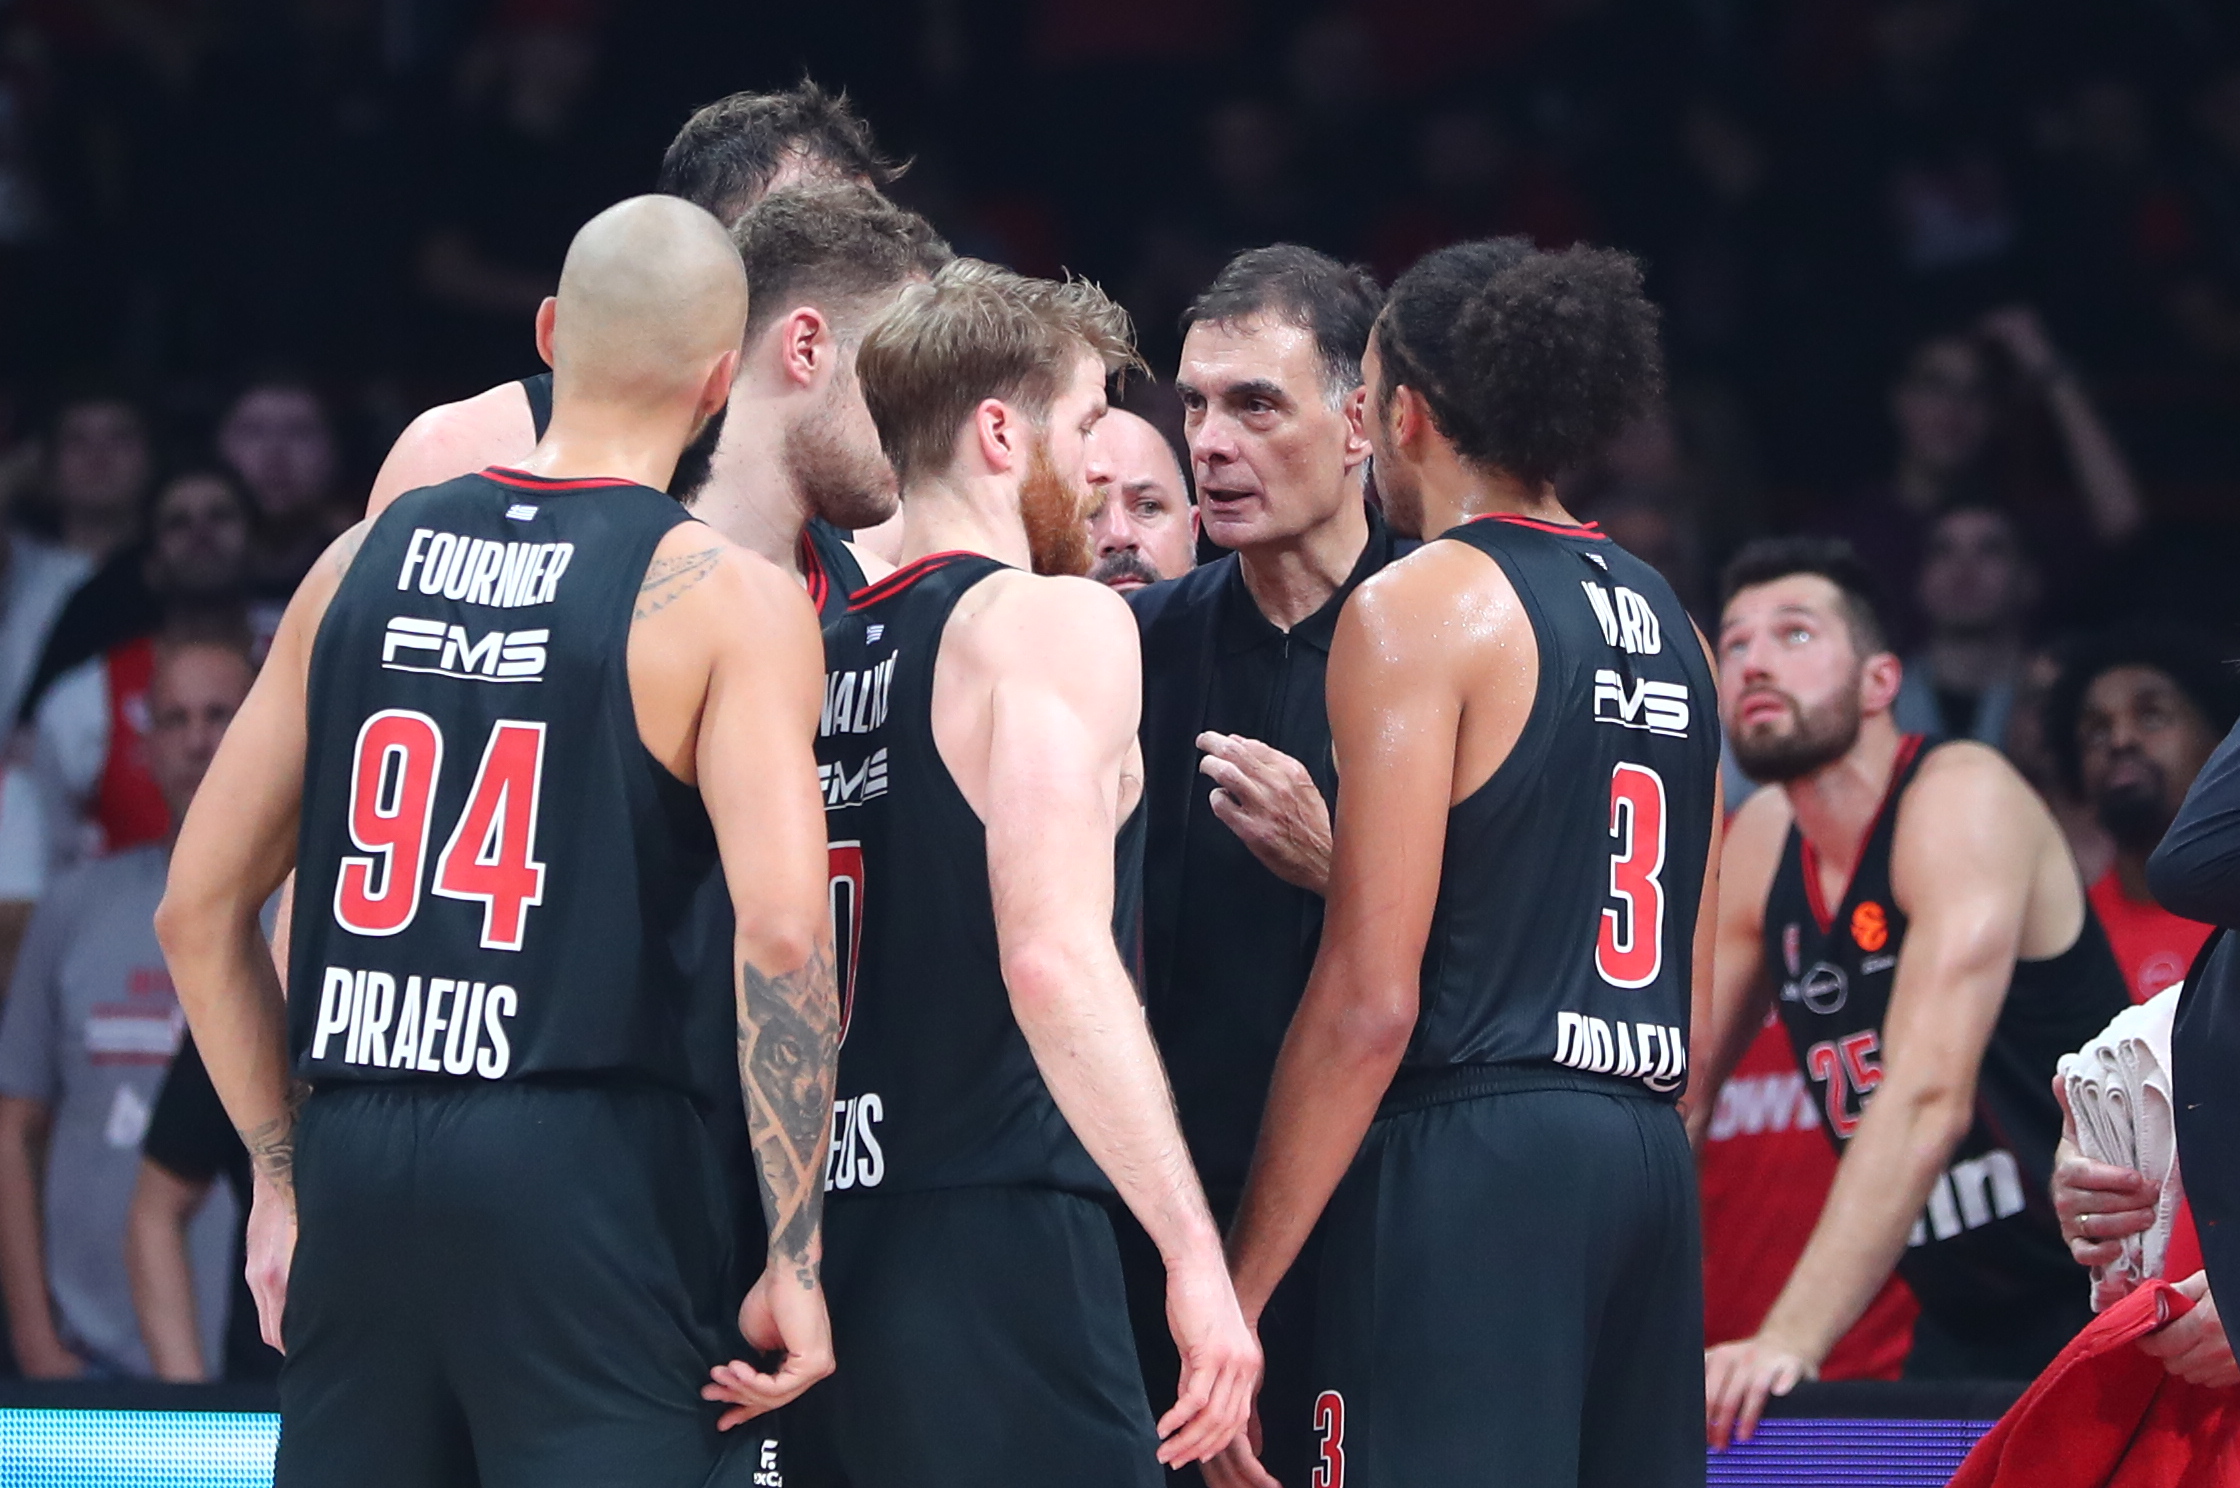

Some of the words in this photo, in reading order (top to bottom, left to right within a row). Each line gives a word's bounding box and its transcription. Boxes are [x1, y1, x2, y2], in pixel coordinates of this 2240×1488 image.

[398, 528, 574, 608] FOURNIER
[1581, 580, 1661, 655] WRD
[382, 617, 549, 678] FMS
[333, 709, 547, 951] 94
[1595, 761, 1667, 989] 3
[312, 967, 518, 1079] PIRAEUS
[1807, 1029, 1884, 1139] 25
[1312, 1389, 1345, 1488] 3
